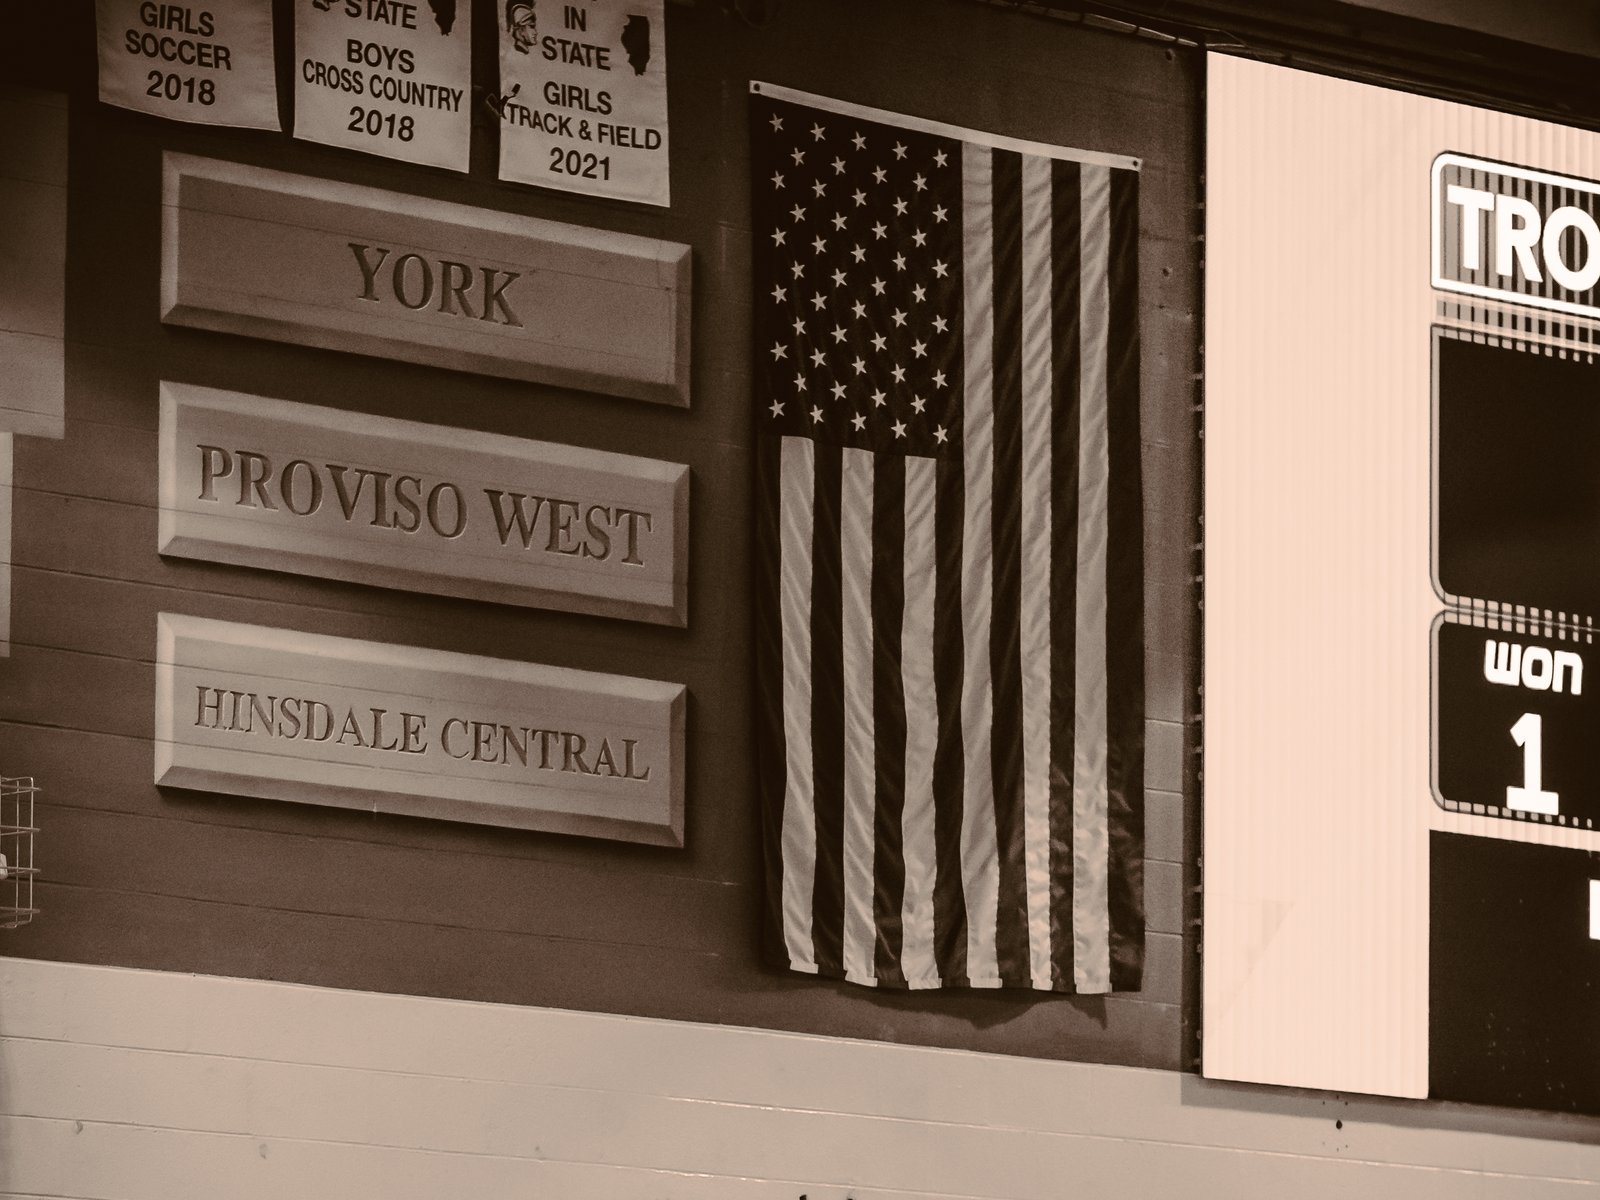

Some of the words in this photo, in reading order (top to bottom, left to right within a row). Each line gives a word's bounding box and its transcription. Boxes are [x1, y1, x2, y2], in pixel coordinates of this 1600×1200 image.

[139, 1, 215, 37] GIRLS
[345, 0, 417, 30] STATE
[564, 5, 587, 32] IN
[125, 29, 231, 71] SOCCER
[346, 38, 415, 74] BOYS
[541, 36, 611, 71] STATE
[146, 70, 216, 106] 2018
[303, 59, 364, 95] CROSS
[369, 74, 464, 112] COUNTRY
[543, 81, 612, 115] GIRLS
[347, 106, 415, 142] 2018
[507, 102, 574, 138] TRACK
[578, 119, 593, 141] &
[597, 122, 662, 150] FIELD
[549, 147, 610, 181] 2021
[1447, 183, 1600, 292] TRO
[347, 242, 524, 328] YORK
[196, 443, 468, 539] PROVISO
[483, 488, 653, 567] WEST
[194, 685, 428, 755] HINSDALE
[440, 717, 651, 781] CENTRAL
[1506, 712, 1560, 816] 1
